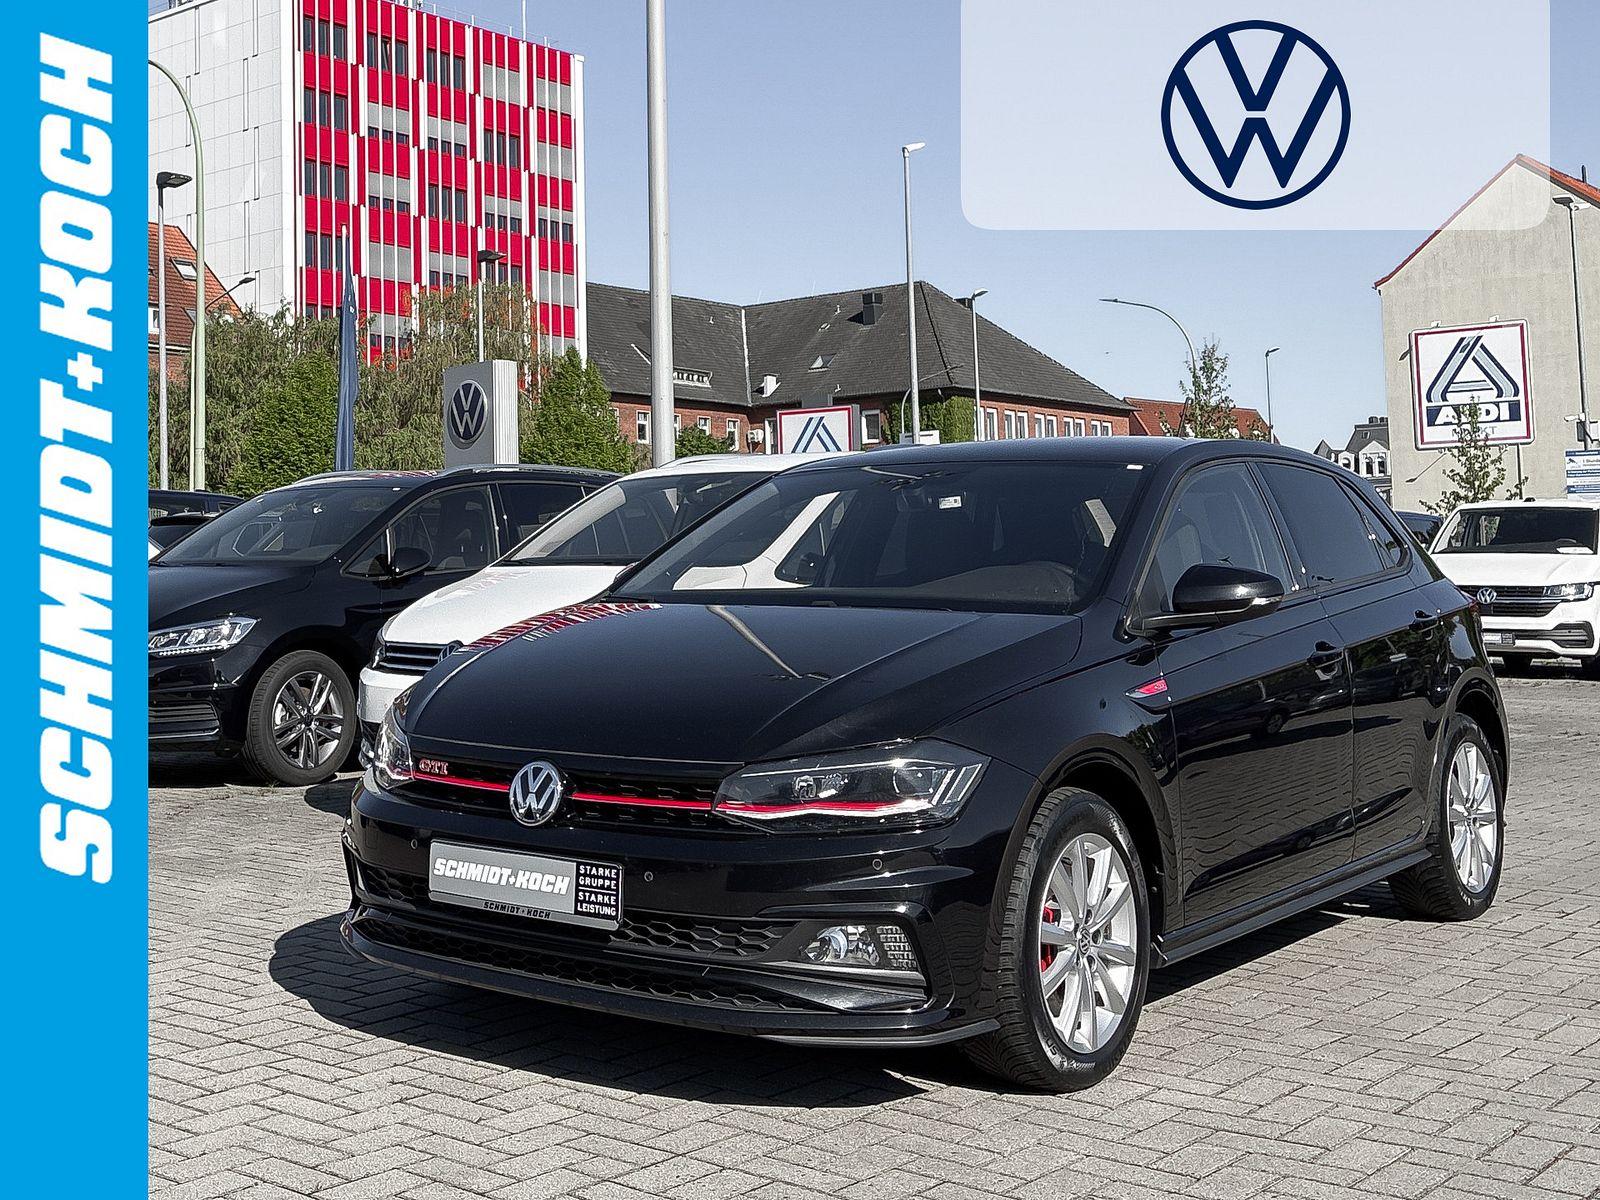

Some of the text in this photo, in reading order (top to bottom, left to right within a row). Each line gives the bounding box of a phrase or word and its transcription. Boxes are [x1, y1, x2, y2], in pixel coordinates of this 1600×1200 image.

[418, 758, 449, 775] GTI
[509, 761, 562, 826] VW
[579, 865, 617, 878] STARKE
[578, 876, 617, 889] GRUPPE
[578, 891, 617, 905] STARKE
[577, 902, 617, 916] LEISTUNG
